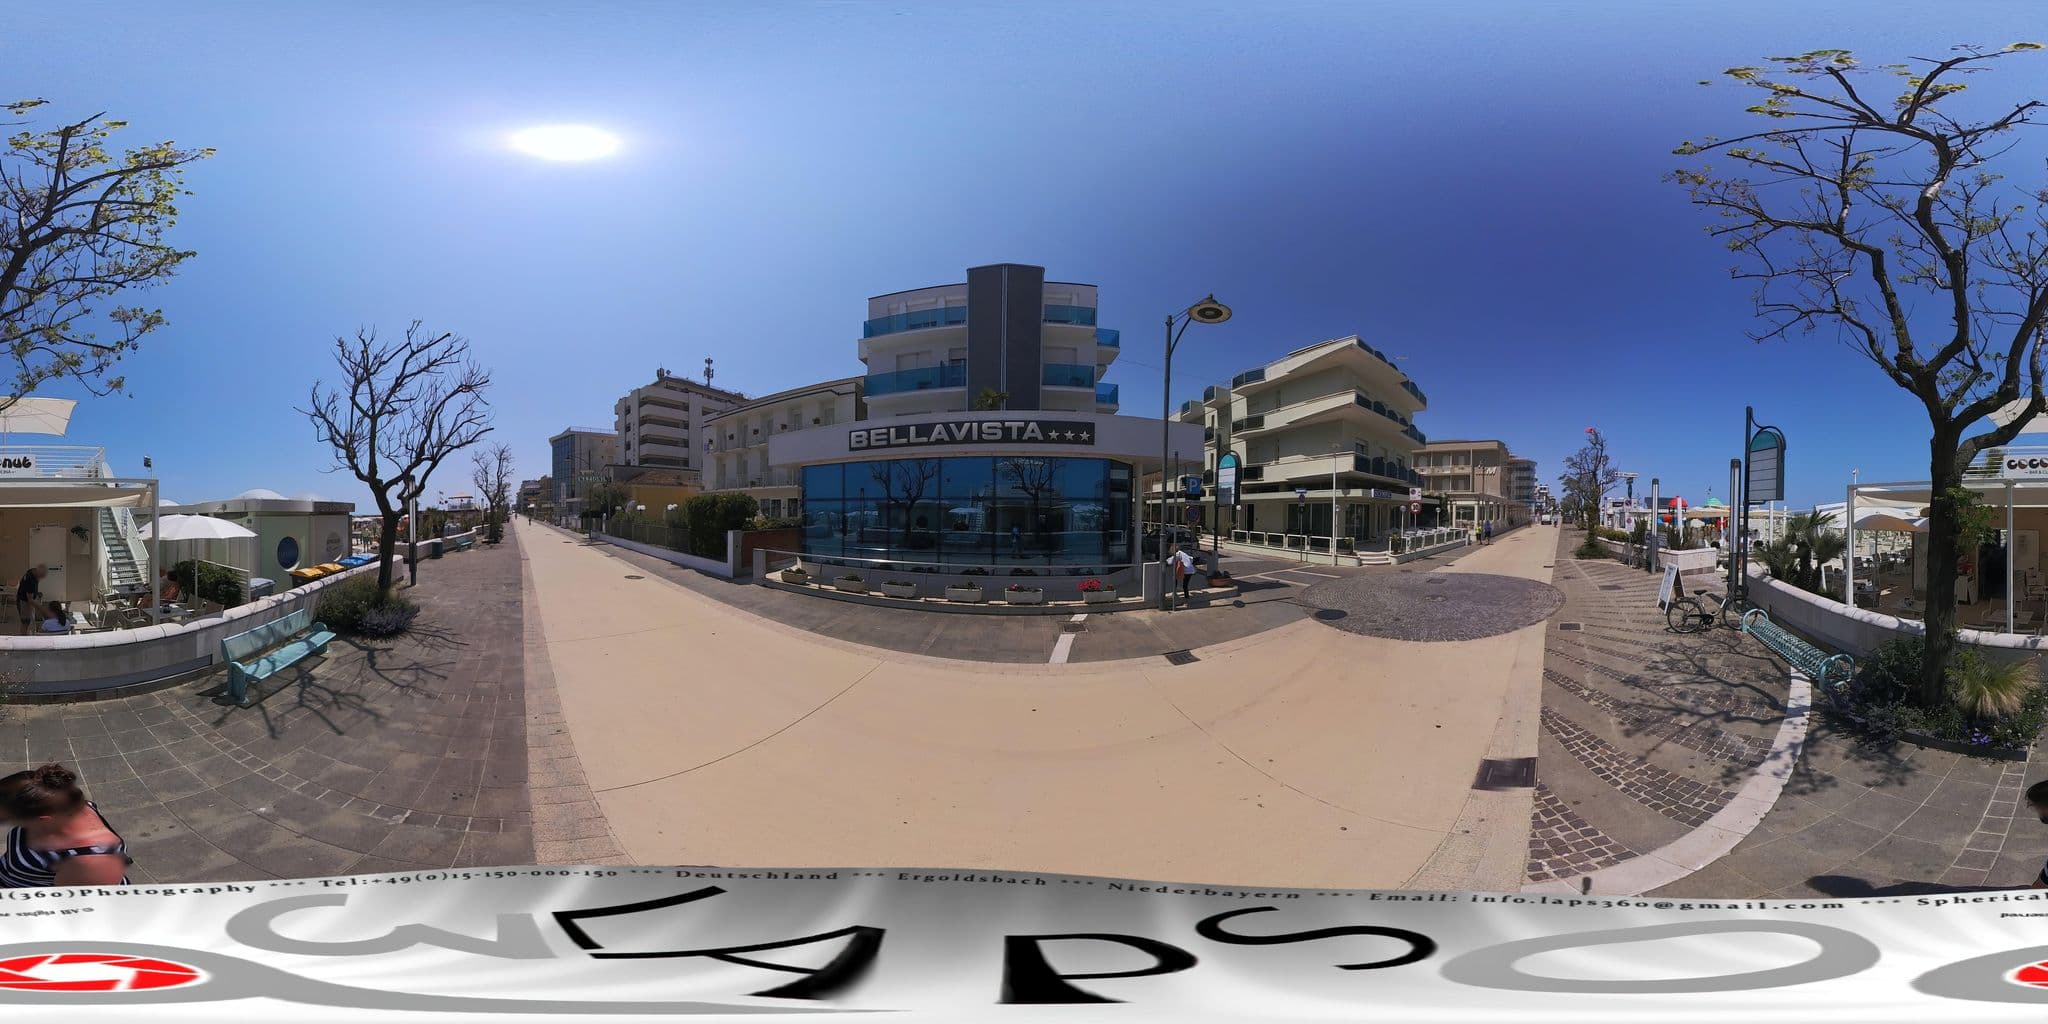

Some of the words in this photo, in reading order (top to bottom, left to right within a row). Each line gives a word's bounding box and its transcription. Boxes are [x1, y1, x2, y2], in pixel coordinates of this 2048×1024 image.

[850, 422, 1044, 449] BELLAVISTA
[0, 456, 32, 469] nut
[1188, 479, 1198, 493] P
